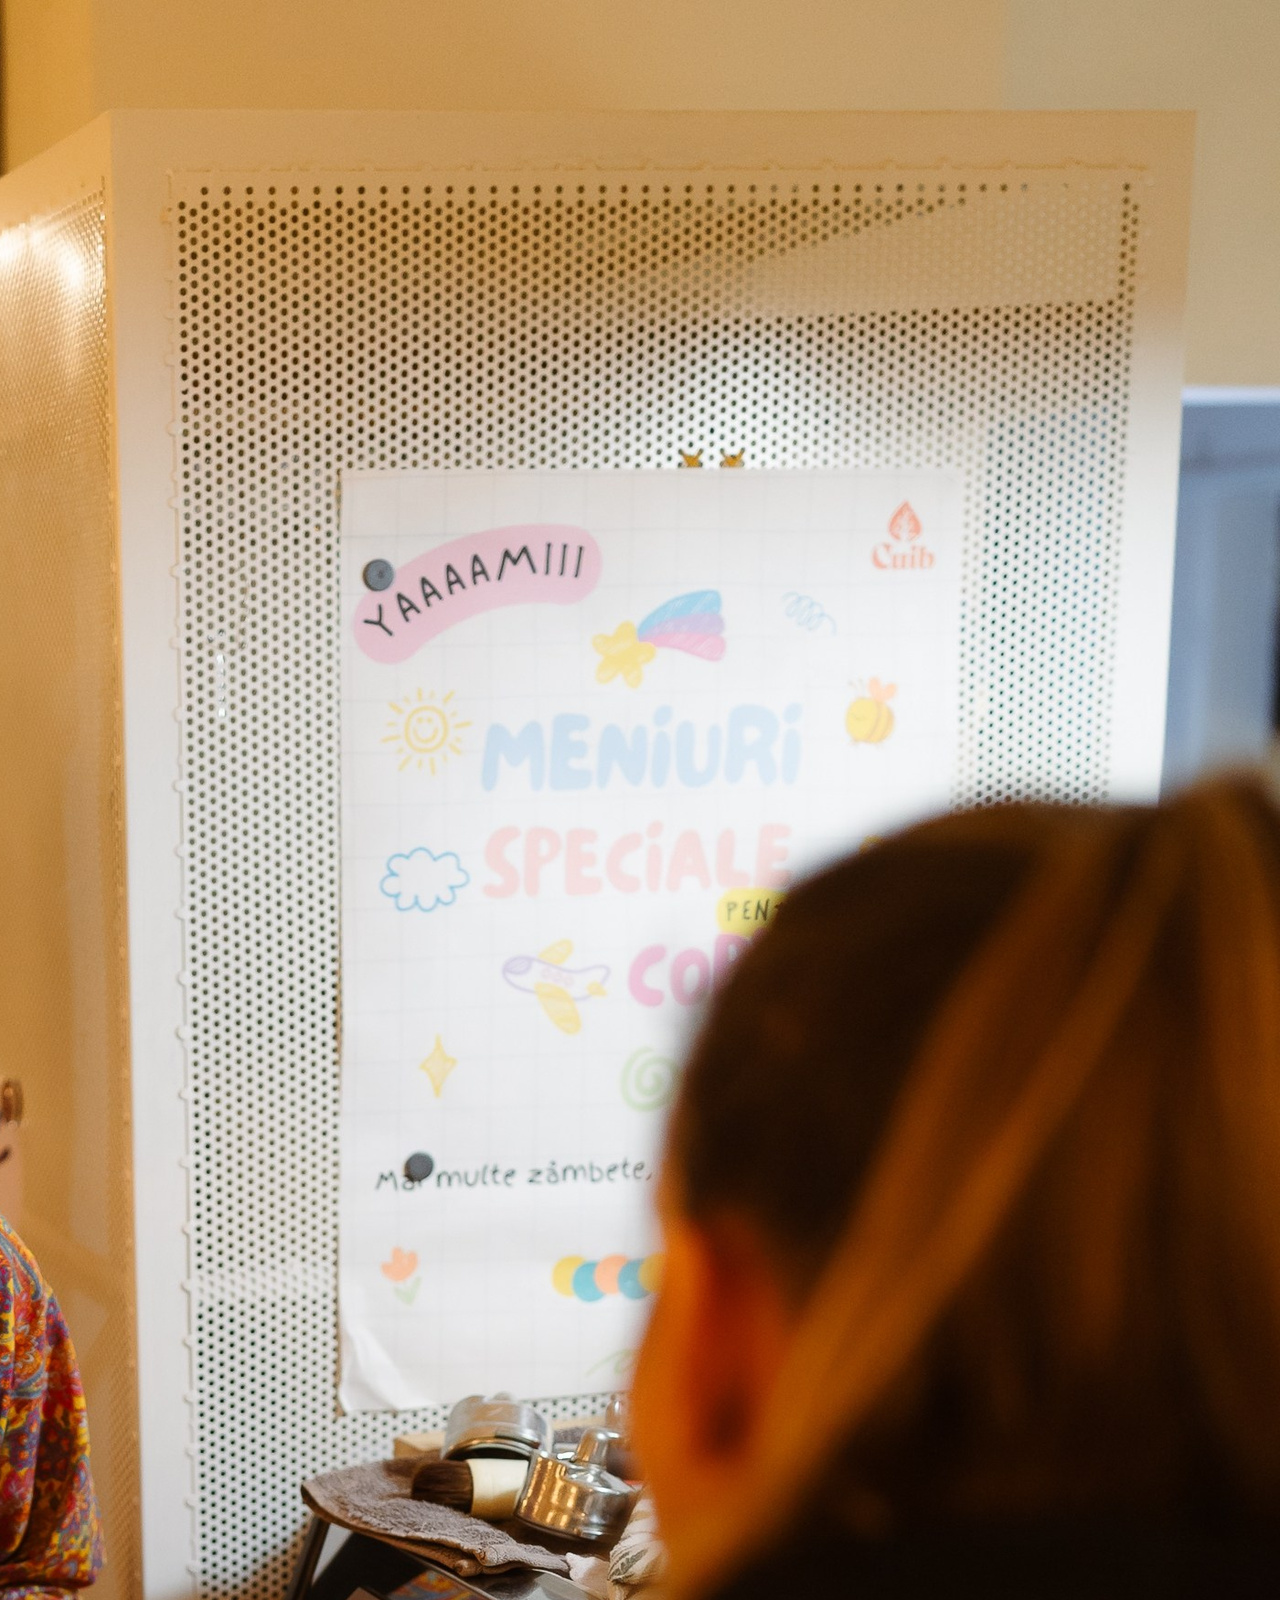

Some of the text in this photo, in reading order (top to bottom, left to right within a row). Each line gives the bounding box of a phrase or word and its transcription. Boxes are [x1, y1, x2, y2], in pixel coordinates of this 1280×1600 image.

[870, 540, 936, 571] Cuib
[363, 542, 585, 636] YAAAAMIII
[726, 898, 784, 921] PEN
[436, 1164, 516, 1189] multe
